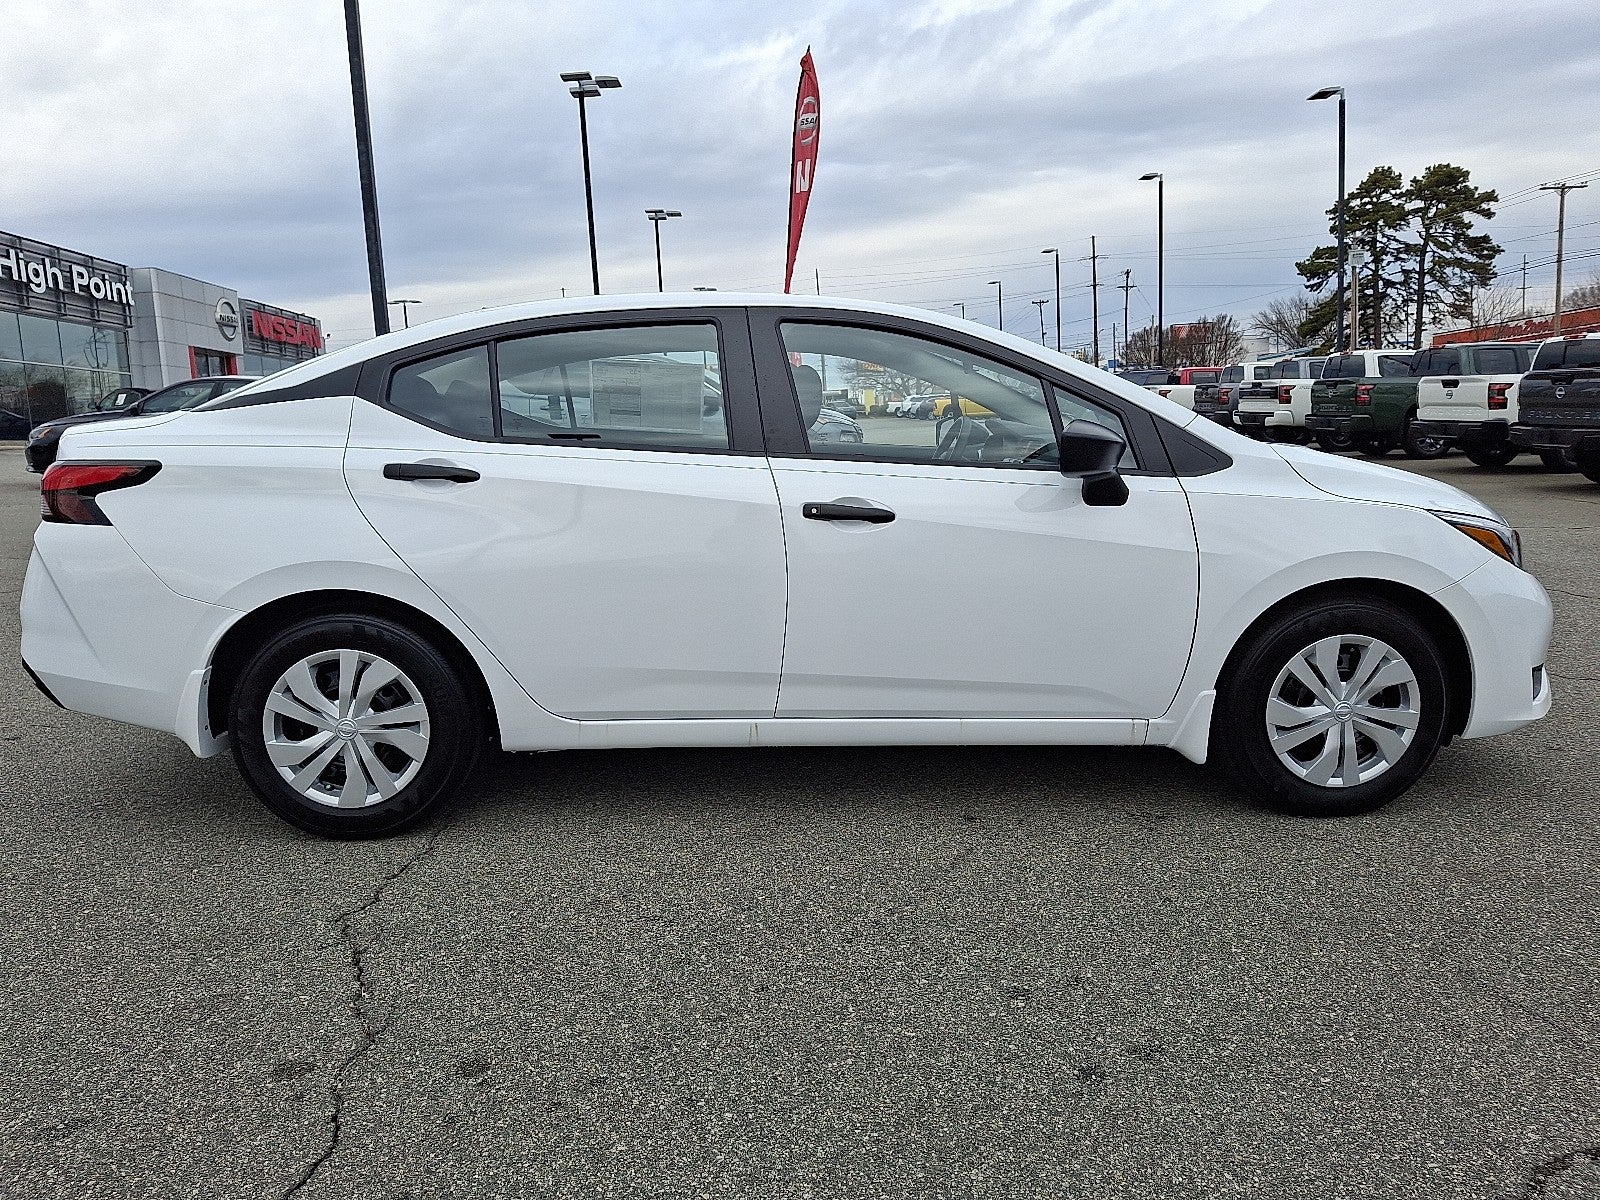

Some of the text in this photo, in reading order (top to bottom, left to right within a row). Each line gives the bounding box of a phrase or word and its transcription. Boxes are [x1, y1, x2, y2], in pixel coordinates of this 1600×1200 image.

[0, 249, 135, 306] High Point
[219, 314, 239, 324] NISSA
[252, 310, 322, 349] NISSAN
